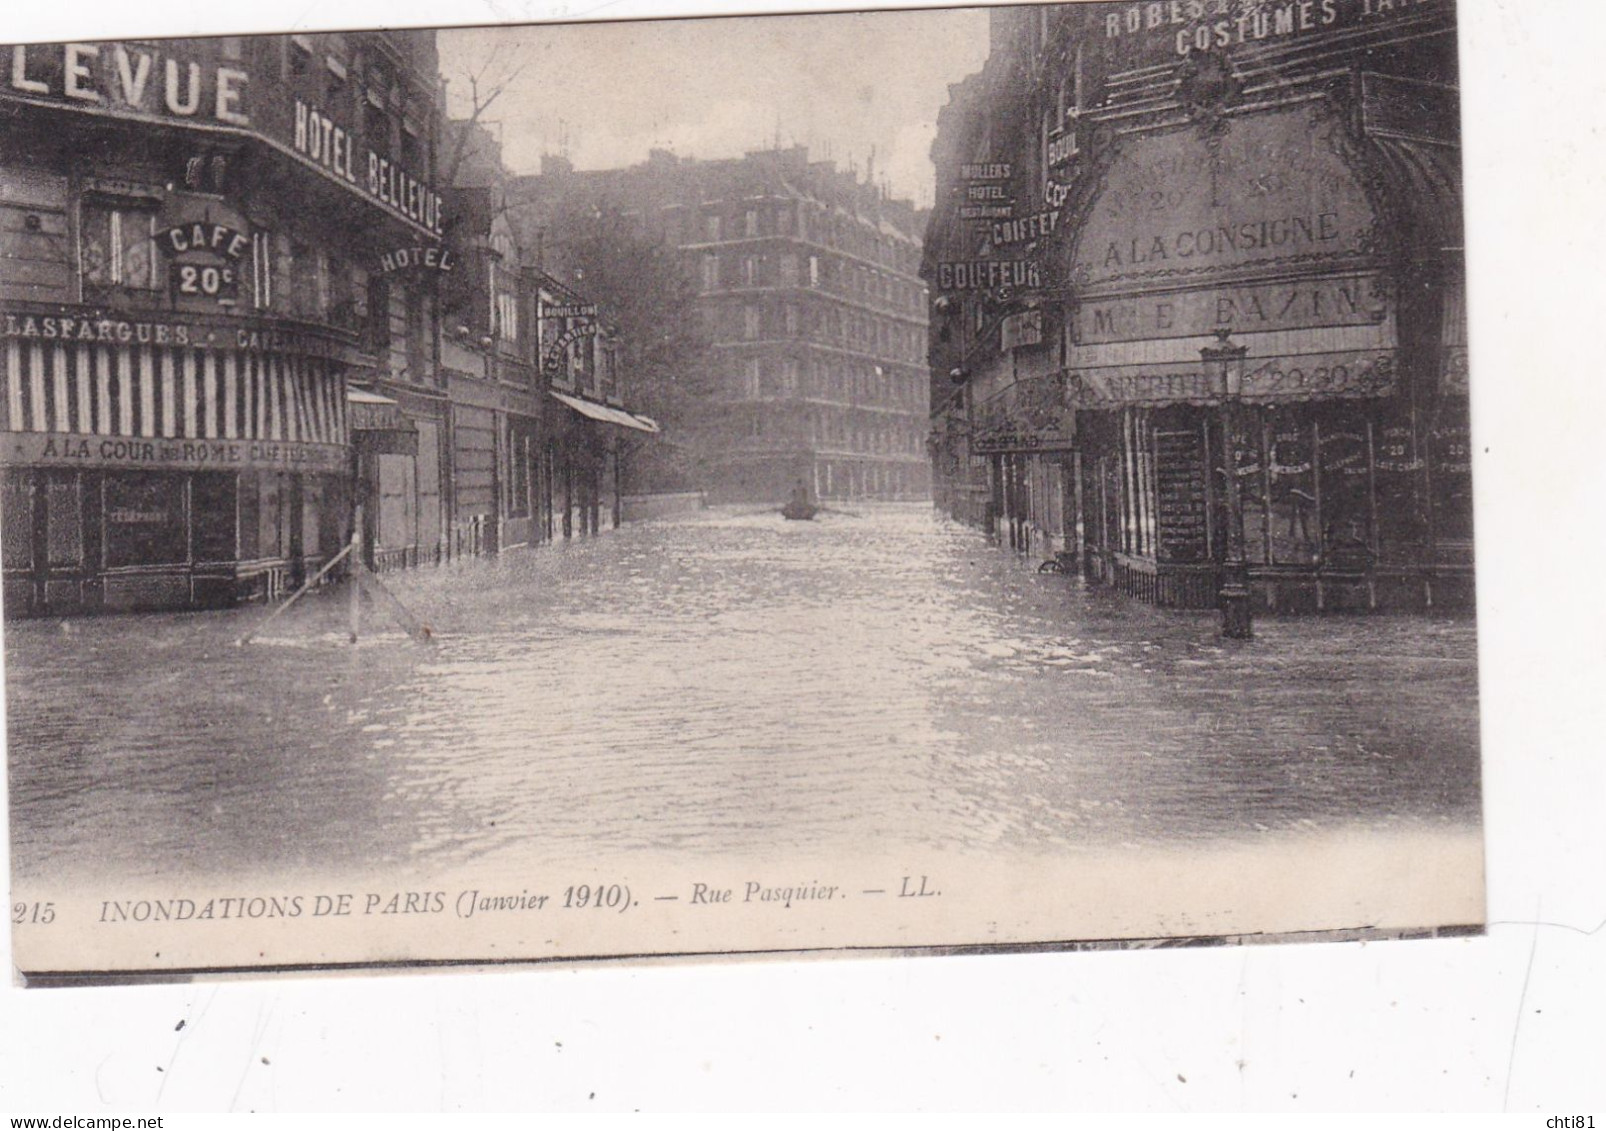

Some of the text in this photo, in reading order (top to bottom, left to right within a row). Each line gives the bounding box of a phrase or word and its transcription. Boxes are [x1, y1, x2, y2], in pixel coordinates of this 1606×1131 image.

[1176, 0, 1336, 55] COSTUMES
[368, 151, 443, 235] BELLEVUE
[1104, 211, 1340, 268] A LA CONSIGNE
[1215, 287, 1358, 324] BAZIN
[5, 315, 189, 345] LASFARGUES
[43, 438, 58, 458] A
[64, 438, 91, 459] LA
[99, 441, 155, 461] COUR
[183, 442, 241, 462] ROME
[12, 902, 56, 925] 215
[99, 895, 304, 923] INONDATIONS
[313, 894, 354, 917] DE
[364, 891, 446, 915] PARIS
[455, 889, 549, 919] (Janvier
[562, 884, 639, 914] 1910).
[690, 882, 732, 905] Rue
[898, 875, 942, 898] LL.
